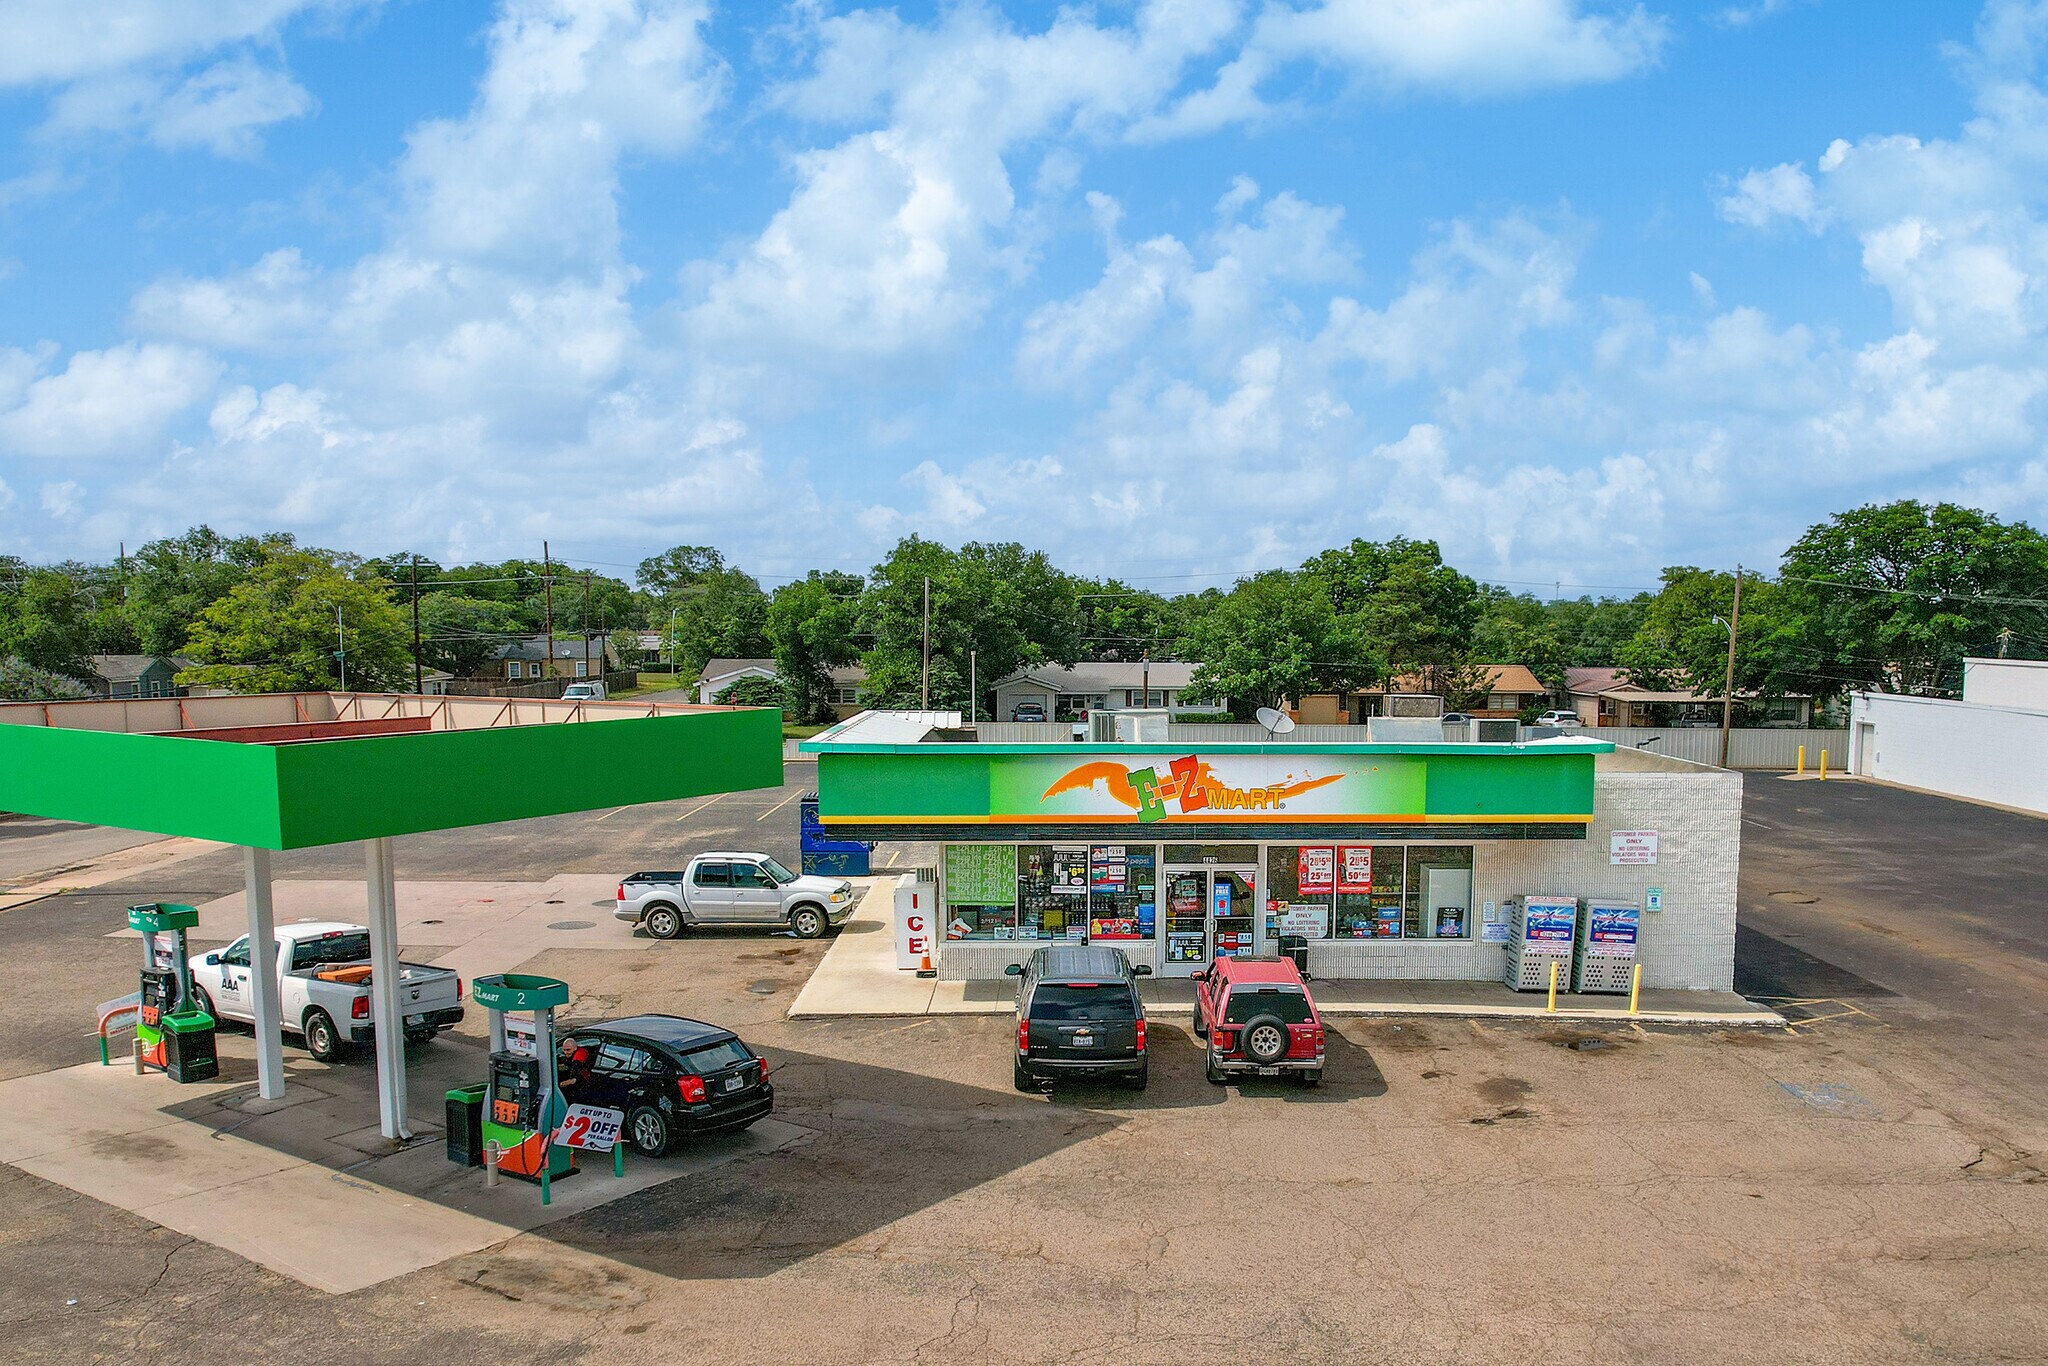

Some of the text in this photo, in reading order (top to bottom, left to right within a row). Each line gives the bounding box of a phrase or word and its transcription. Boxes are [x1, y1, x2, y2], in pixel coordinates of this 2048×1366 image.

[1208, 788, 1286, 810] MART
[1130, 857, 1150, 866] pepsi
[153, 917, 158, 927] 4
[908, 893, 924, 954] ICE
[481, 992, 500, 1002] MART
[517, 992, 526, 1005] 2
[603, 1111, 612, 1119] TO
[591, 1120, 619, 1136] OFF
